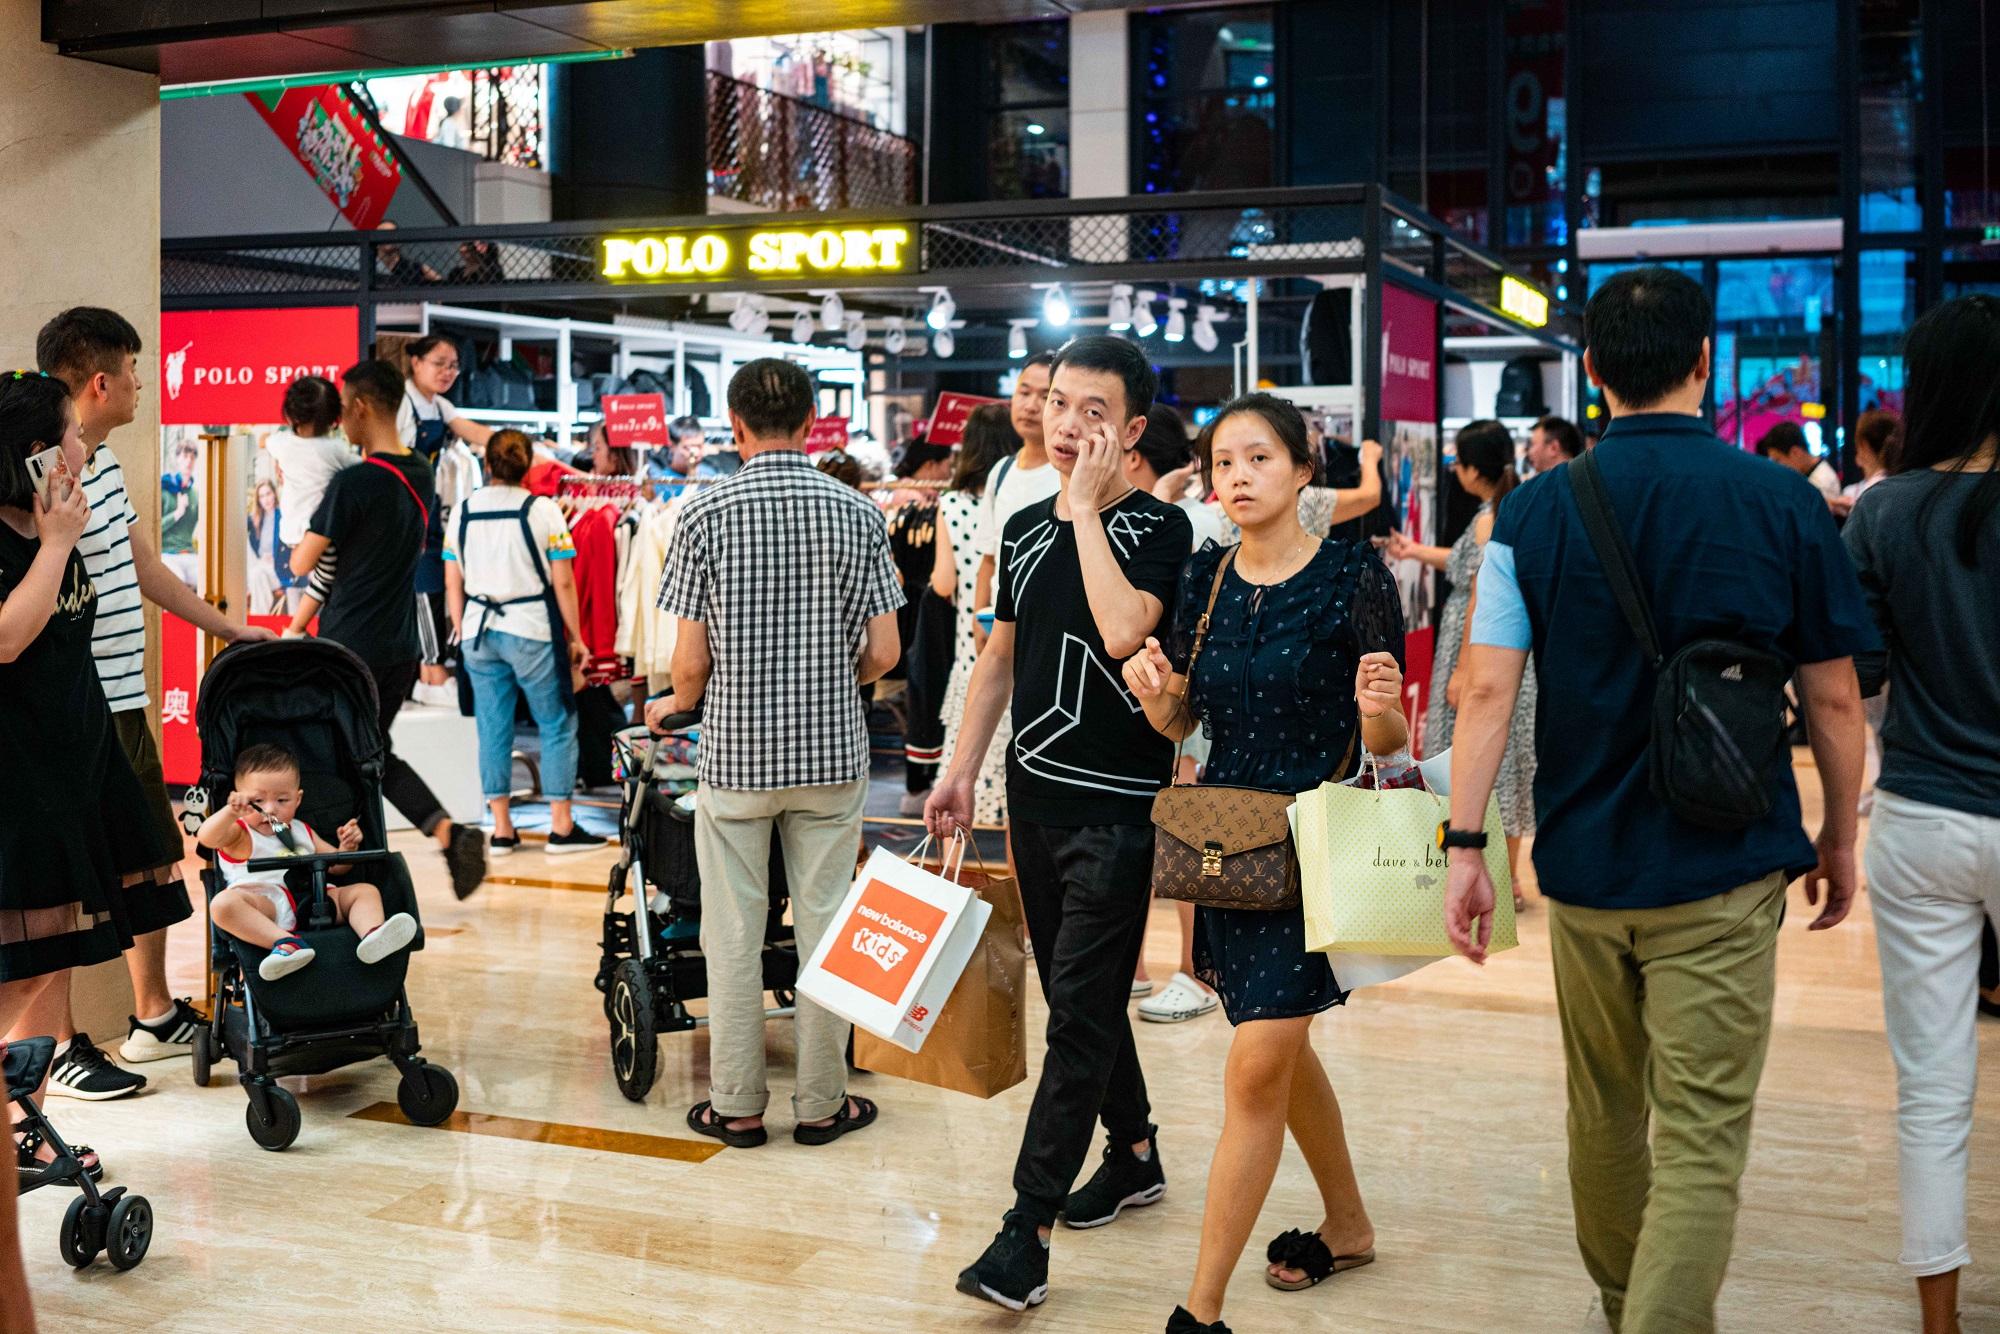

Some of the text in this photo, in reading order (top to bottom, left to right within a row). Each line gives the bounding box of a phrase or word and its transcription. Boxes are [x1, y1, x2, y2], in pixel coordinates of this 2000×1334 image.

[603, 229, 907, 275] POLO SPORT
[193, 366, 254, 385] POLO
[162, 687, 190, 725] 奥
[1372, 846, 1405, 867] dave
[1425, 843, 1450, 867] bel
[857, 905, 928, 943] new balance
